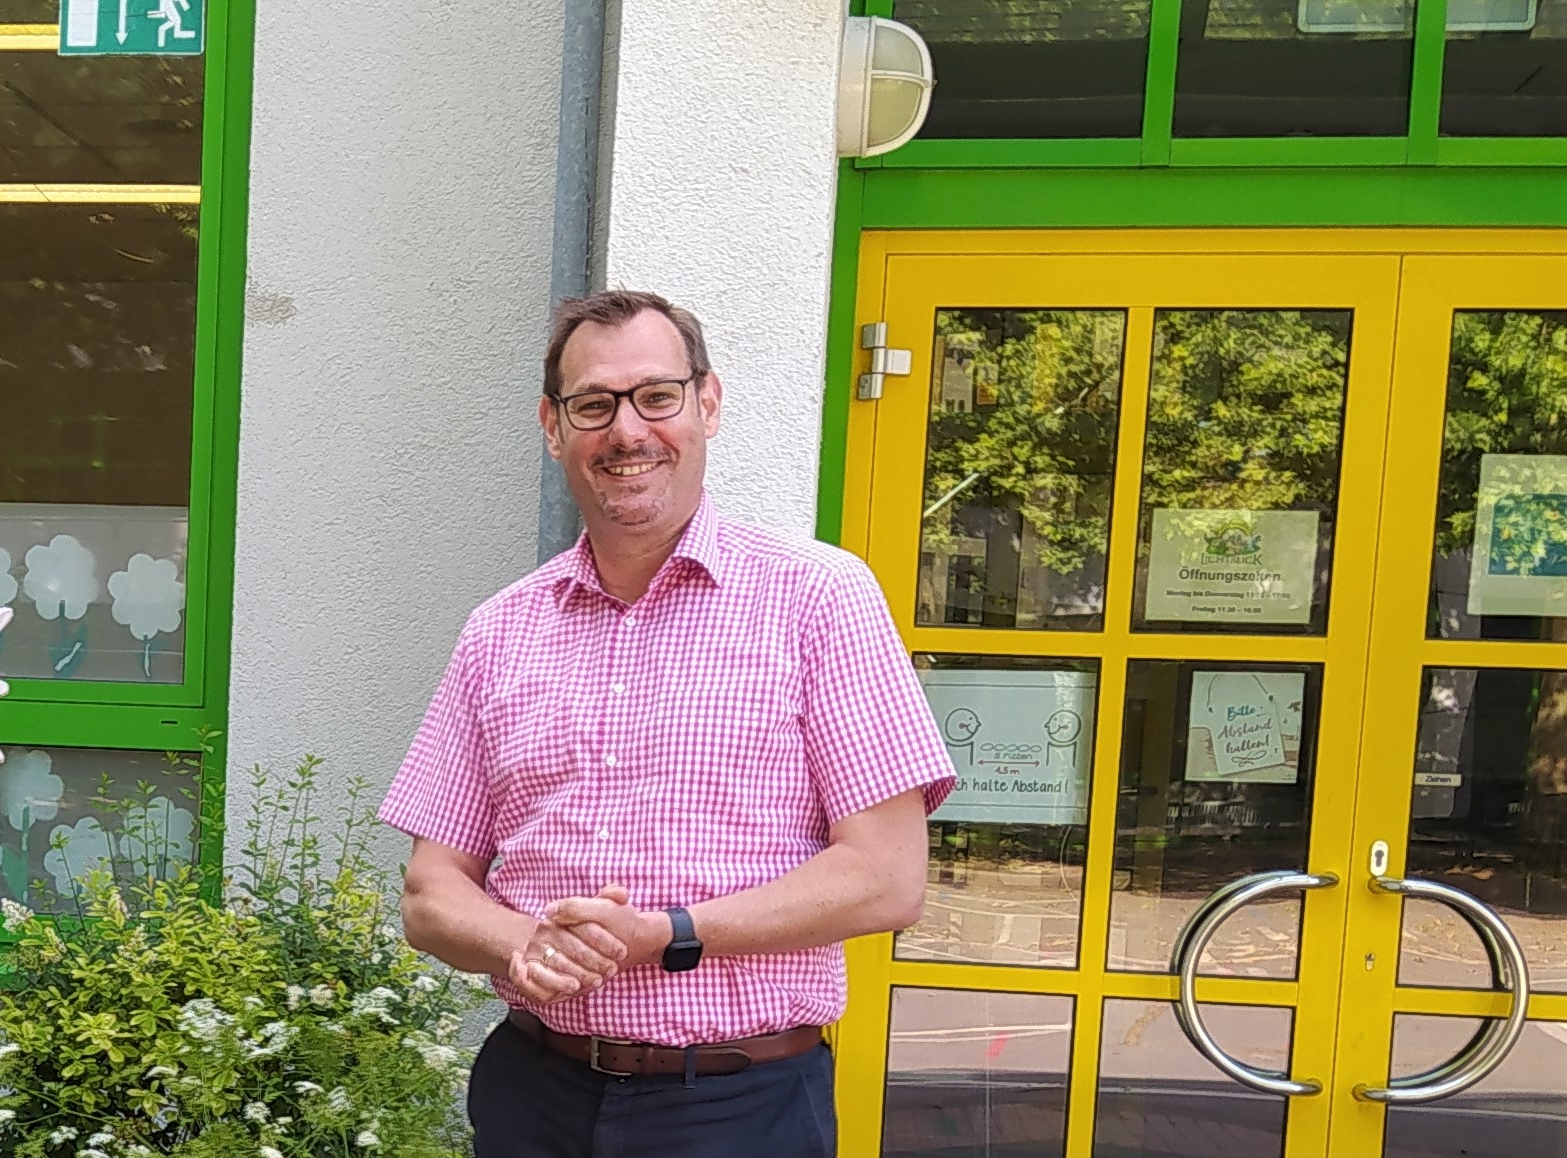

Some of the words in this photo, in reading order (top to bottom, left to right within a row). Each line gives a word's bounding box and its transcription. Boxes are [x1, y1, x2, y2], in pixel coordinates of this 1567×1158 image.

[1227, 704, 1256, 722] Bitte
[1217, 717, 1273, 740] Abstand
[954, 777, 968, 792] ch
[972, 778, 1009, 793] halte
[1010, 778, 1069, 793] Abstand!
